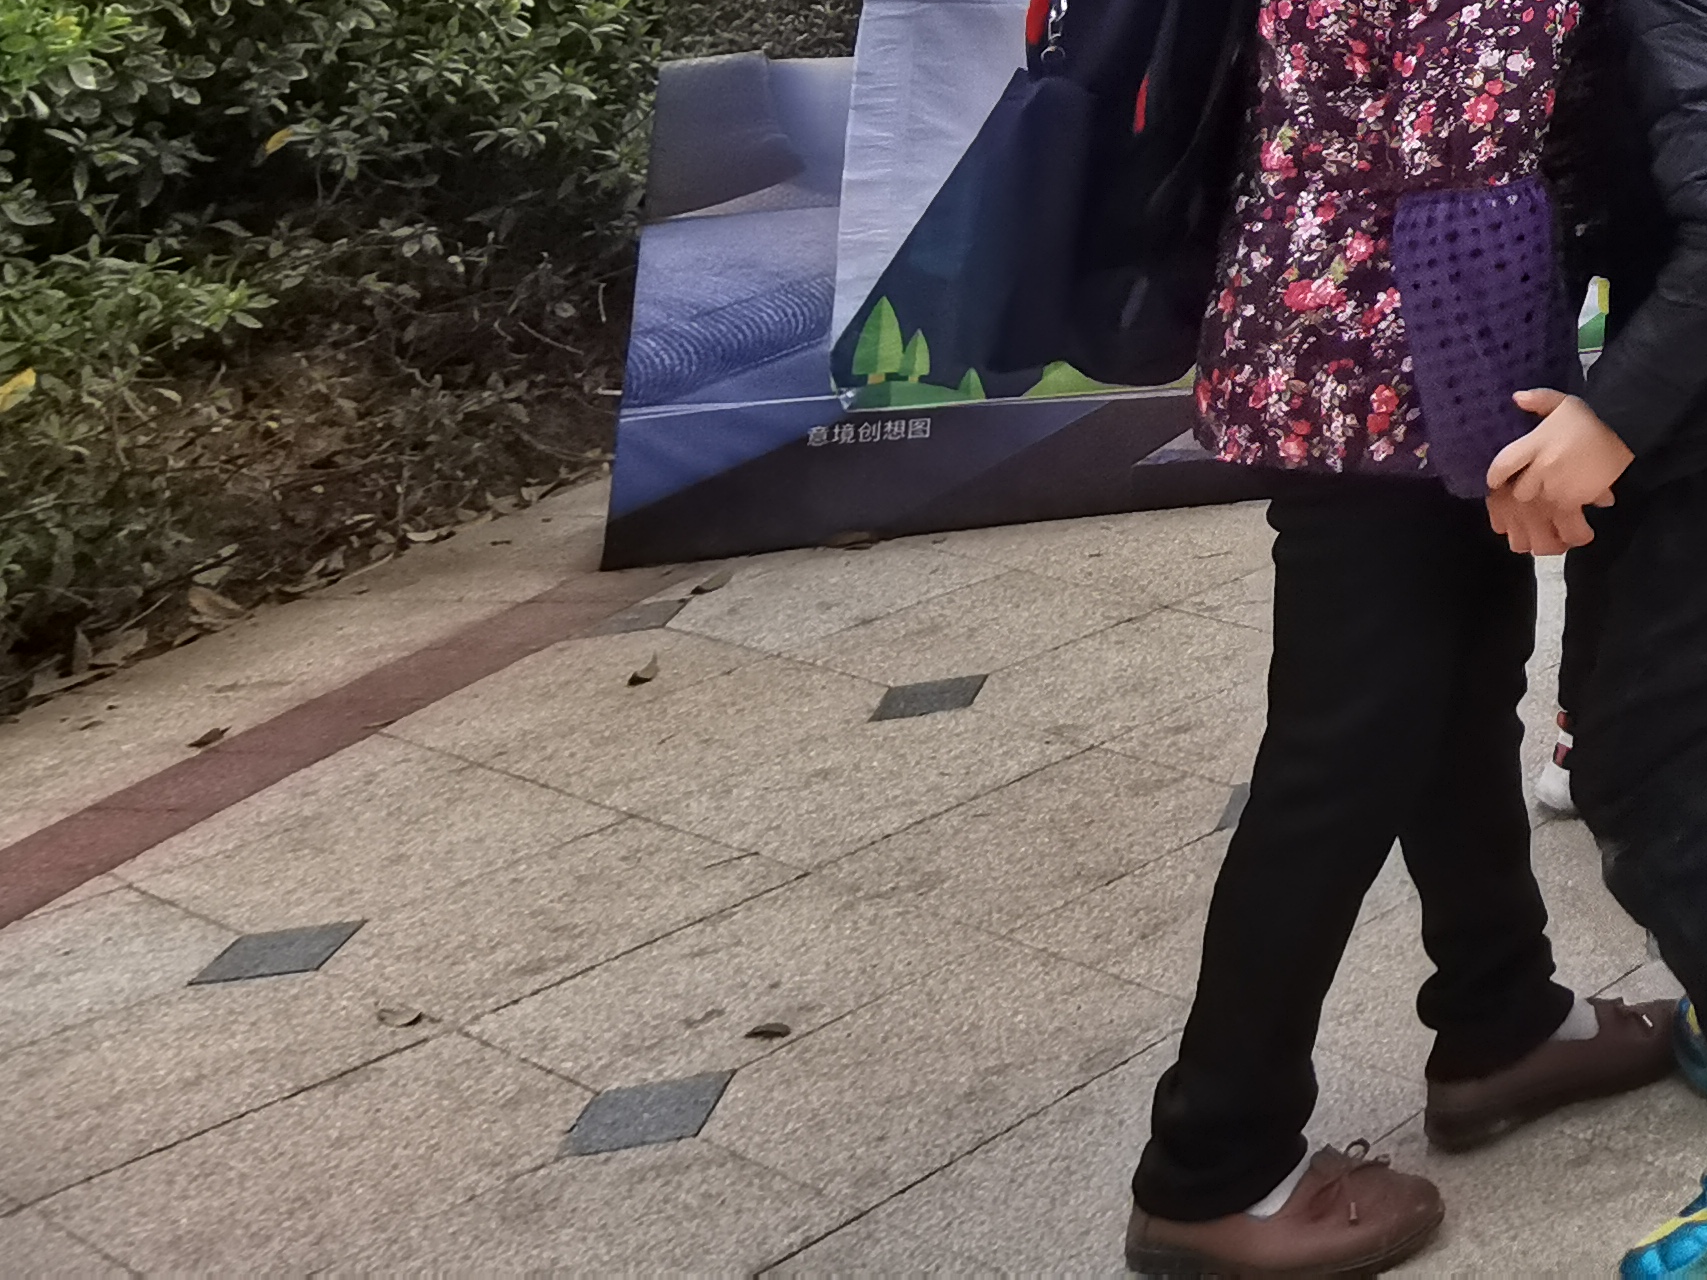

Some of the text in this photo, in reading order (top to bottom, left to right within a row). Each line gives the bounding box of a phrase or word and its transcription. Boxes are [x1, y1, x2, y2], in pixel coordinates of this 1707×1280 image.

[807, 418, 932, 447] 意境创想图
